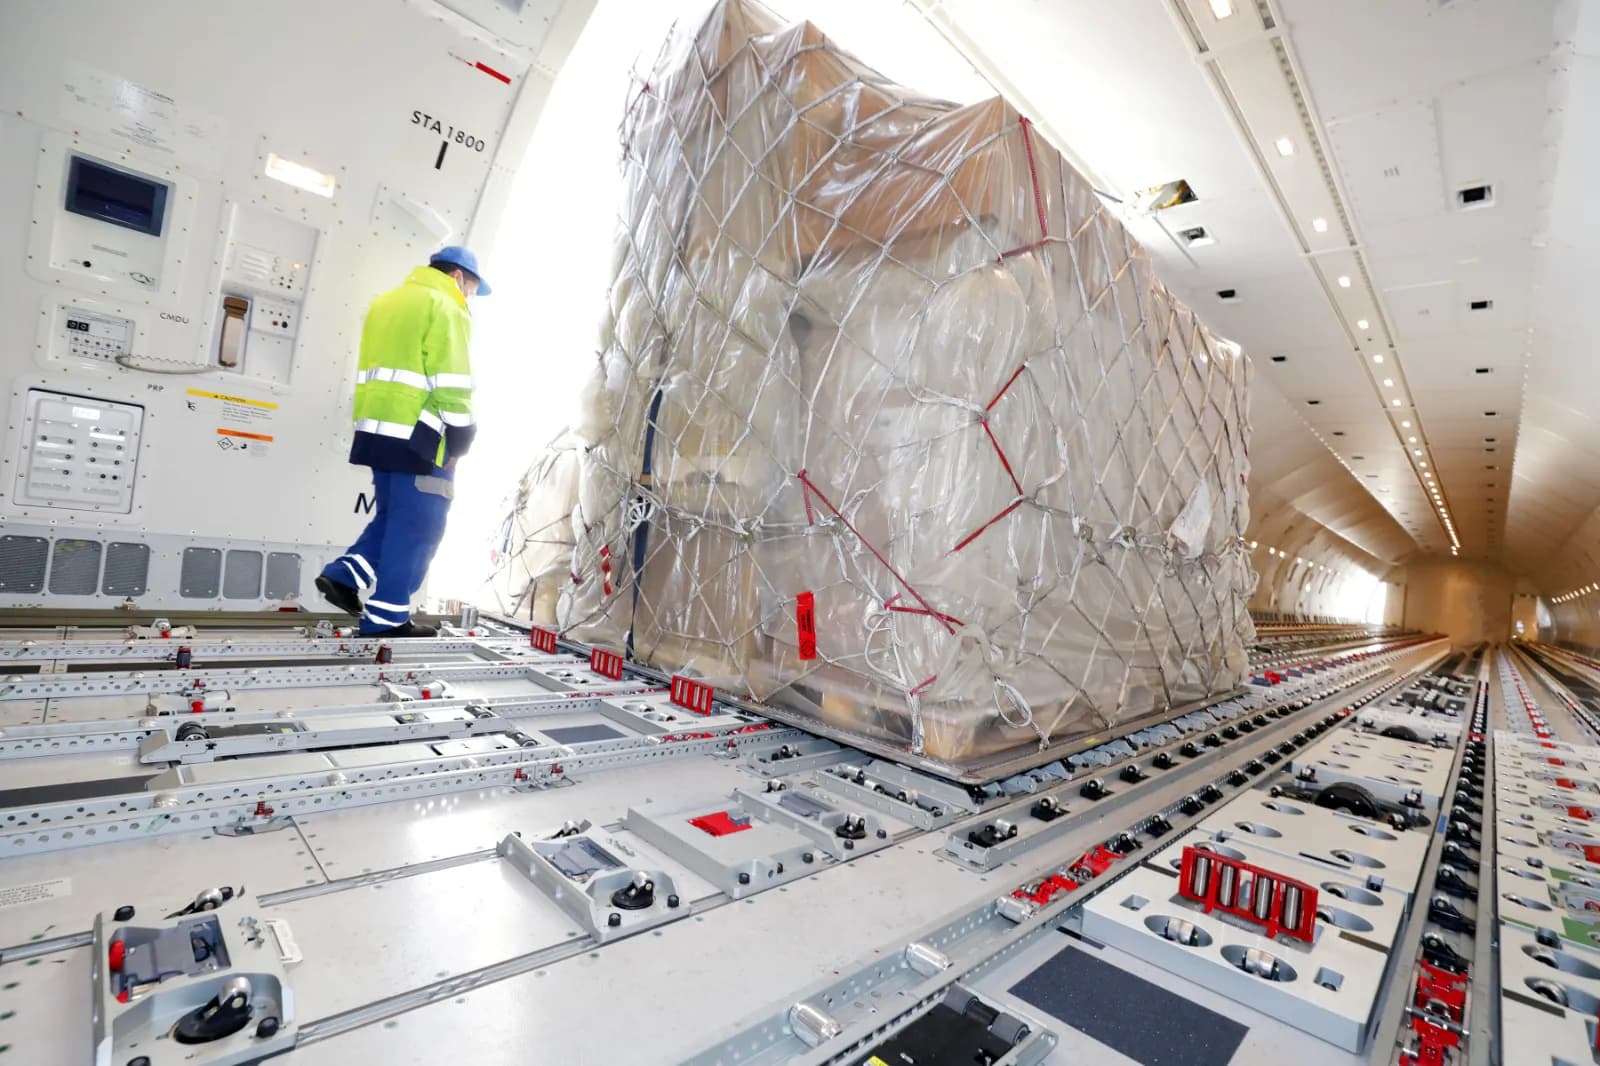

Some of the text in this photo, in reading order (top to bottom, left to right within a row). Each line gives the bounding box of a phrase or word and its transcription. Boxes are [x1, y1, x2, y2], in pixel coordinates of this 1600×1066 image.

[411, 110, 485, 152] STA 1800
[159, 312, 190, 324] CMDU
[147, 383, 165, 392] PRP
